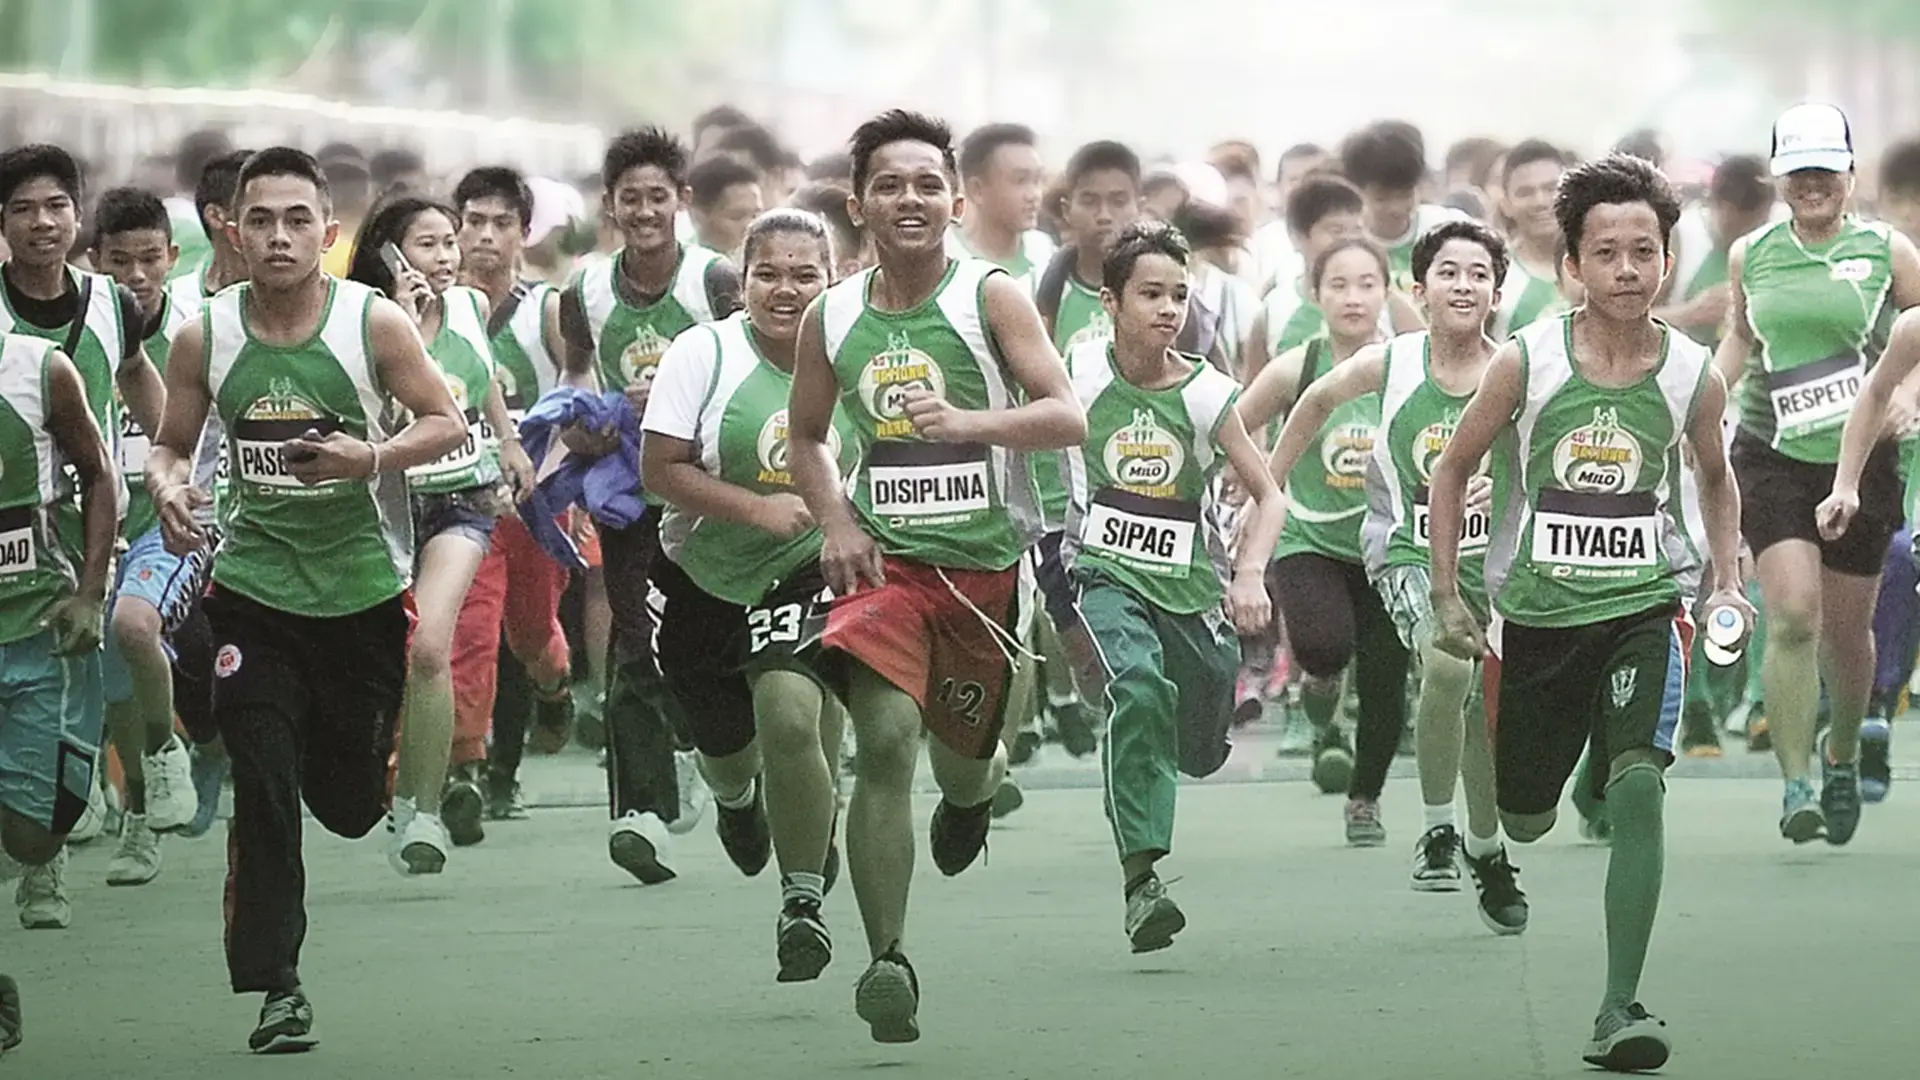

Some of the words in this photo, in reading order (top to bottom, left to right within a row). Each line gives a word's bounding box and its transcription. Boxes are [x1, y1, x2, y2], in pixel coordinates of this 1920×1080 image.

[1778, 376, 1860, 417] RESPETO
[875, 473, 985, 505] DISIPLINA
[1128, 466, 1162, 477] MILO
[1578, 471, 1616, 486] MILO
[1102, 517, 1176, 558] SIPAG
[1547, 523, 1646, 559] TIYAGA
[748, 602, 801, 653] 23
[936, 676, 985, 727] 12
